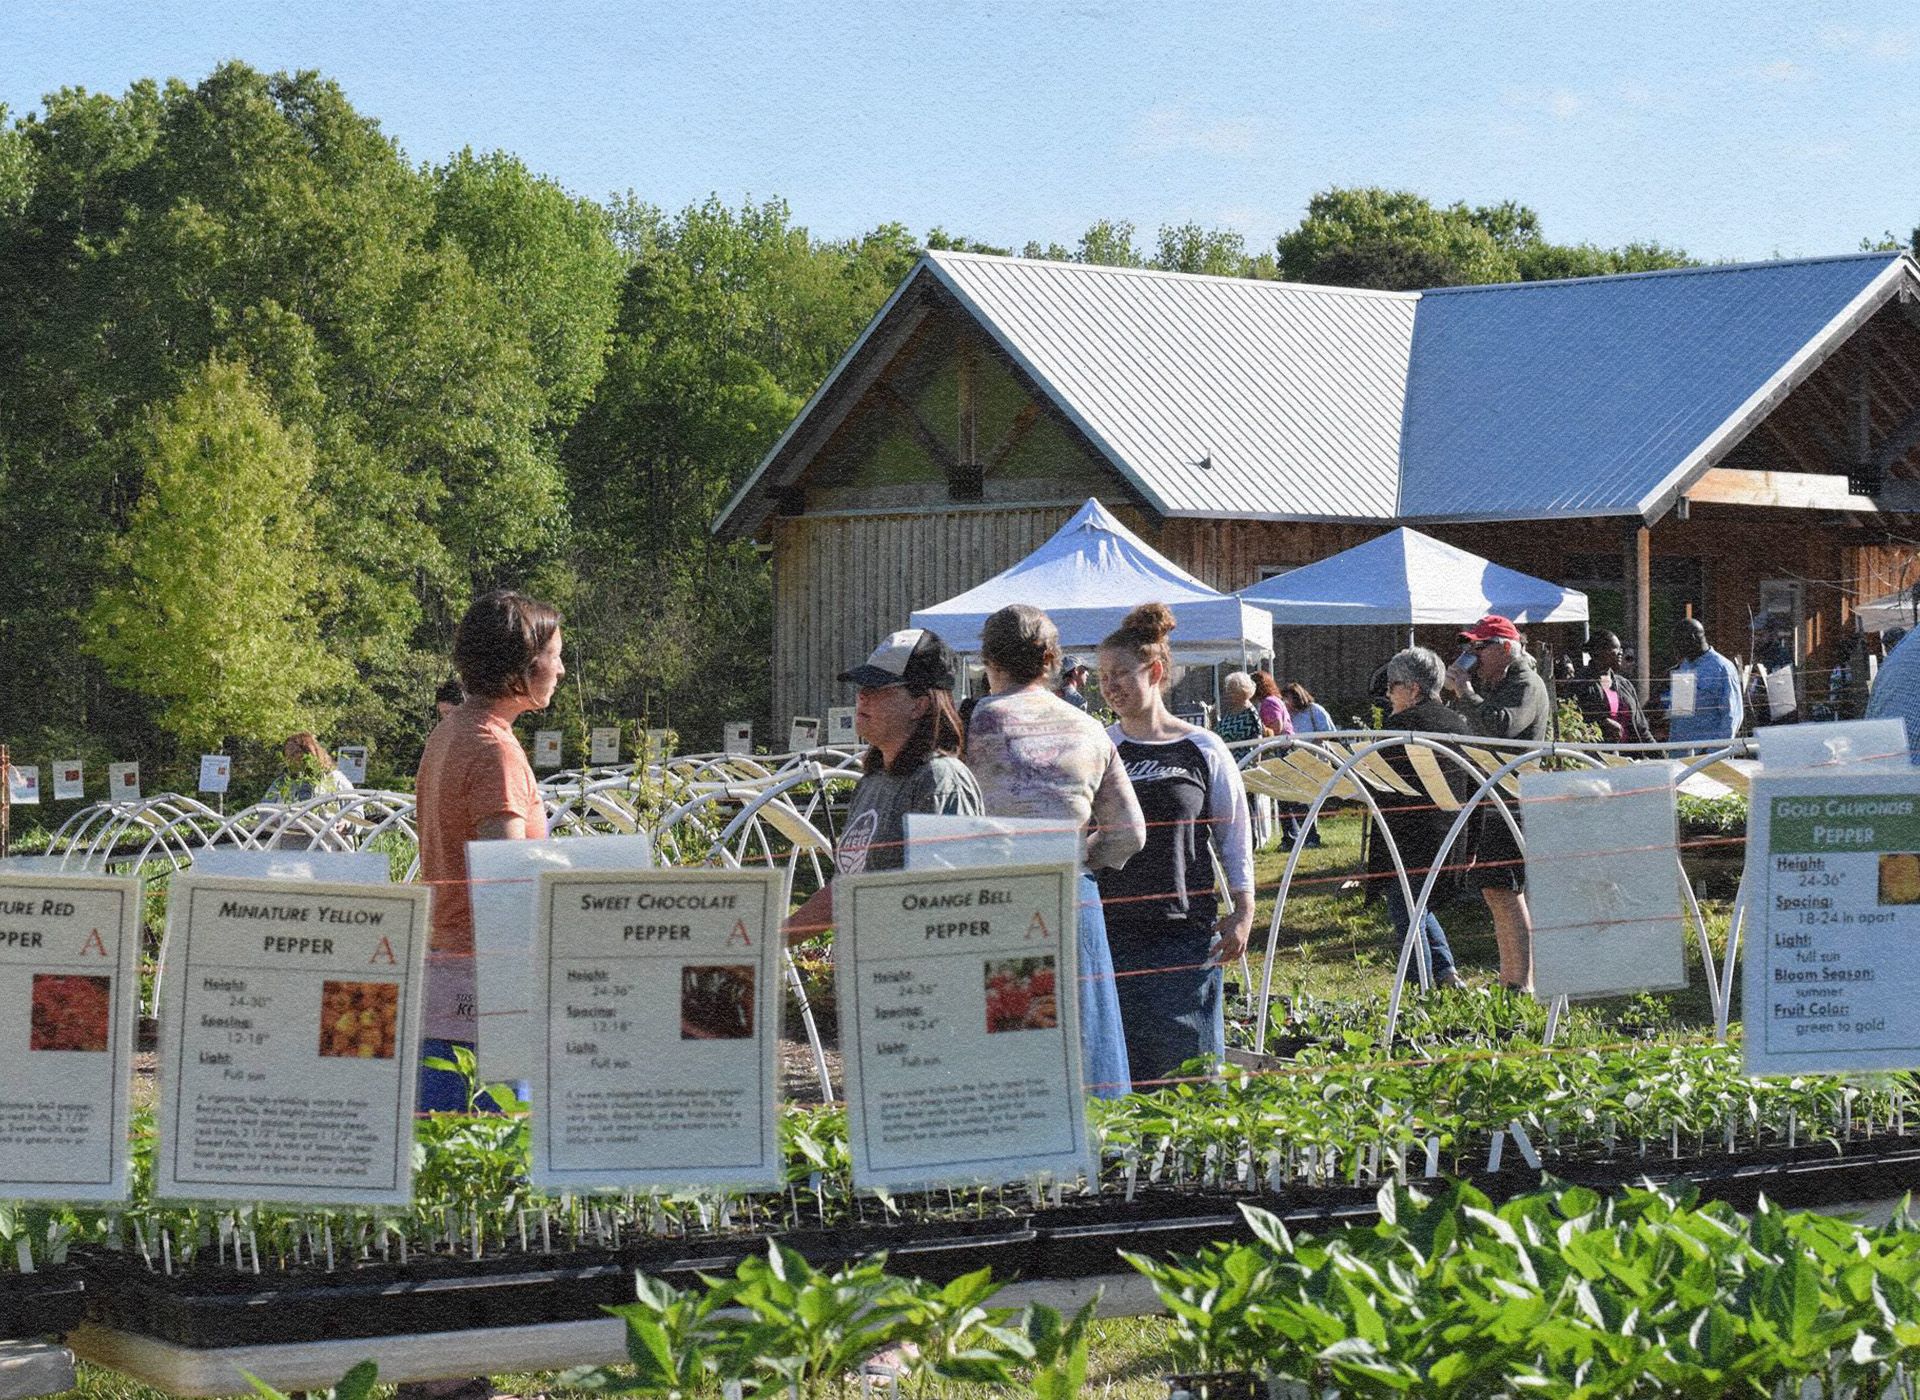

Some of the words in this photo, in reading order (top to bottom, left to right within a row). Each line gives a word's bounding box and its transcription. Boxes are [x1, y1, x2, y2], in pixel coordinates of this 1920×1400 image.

[1777, 801, 1820, 818] GOLD
[1813, 825, 1875, 843] PEPPER
[1777, 856, 1826, 873] Height:
[41, 899, 75, 916] RED
[581, 894, 630, 911] SWEET
[637, 894, 738, 911] CHOCOLATE
[902, 892, 972, 911] ORANGE
[978, 889, 1014, 907] BELL
[1775, 894, 1834, 911] Spacing:
[218, 902, 308, 922] MINIATURE
[318, 906, 385, 926] YELLOW
[1798, 911, 1838, 925] 18-24
[1843, 911, 1854, 924] in
[1857, 912, 1896, 926] apart
[623, 925, 691, 942] PEPPER
[925, 921, 991, 940] PEPPER
[264, 936, 334, 955] PEPPER
[1775, 933, 1812, 948] Light:
[1774, 968, 1818, 983] Bloom
[1822, 967, 1875, 983] Season:
[1796, 988, 1844, 998] summer
[1774, 1003, 1805, 1019] Fruit
[1809, 1002, 1850, 1018] Color:
[1796, 1022, 1834, 1037] green
[1838, 1021, 1851, 1033] to
[1855, 1017, 1885, 1034] gold
